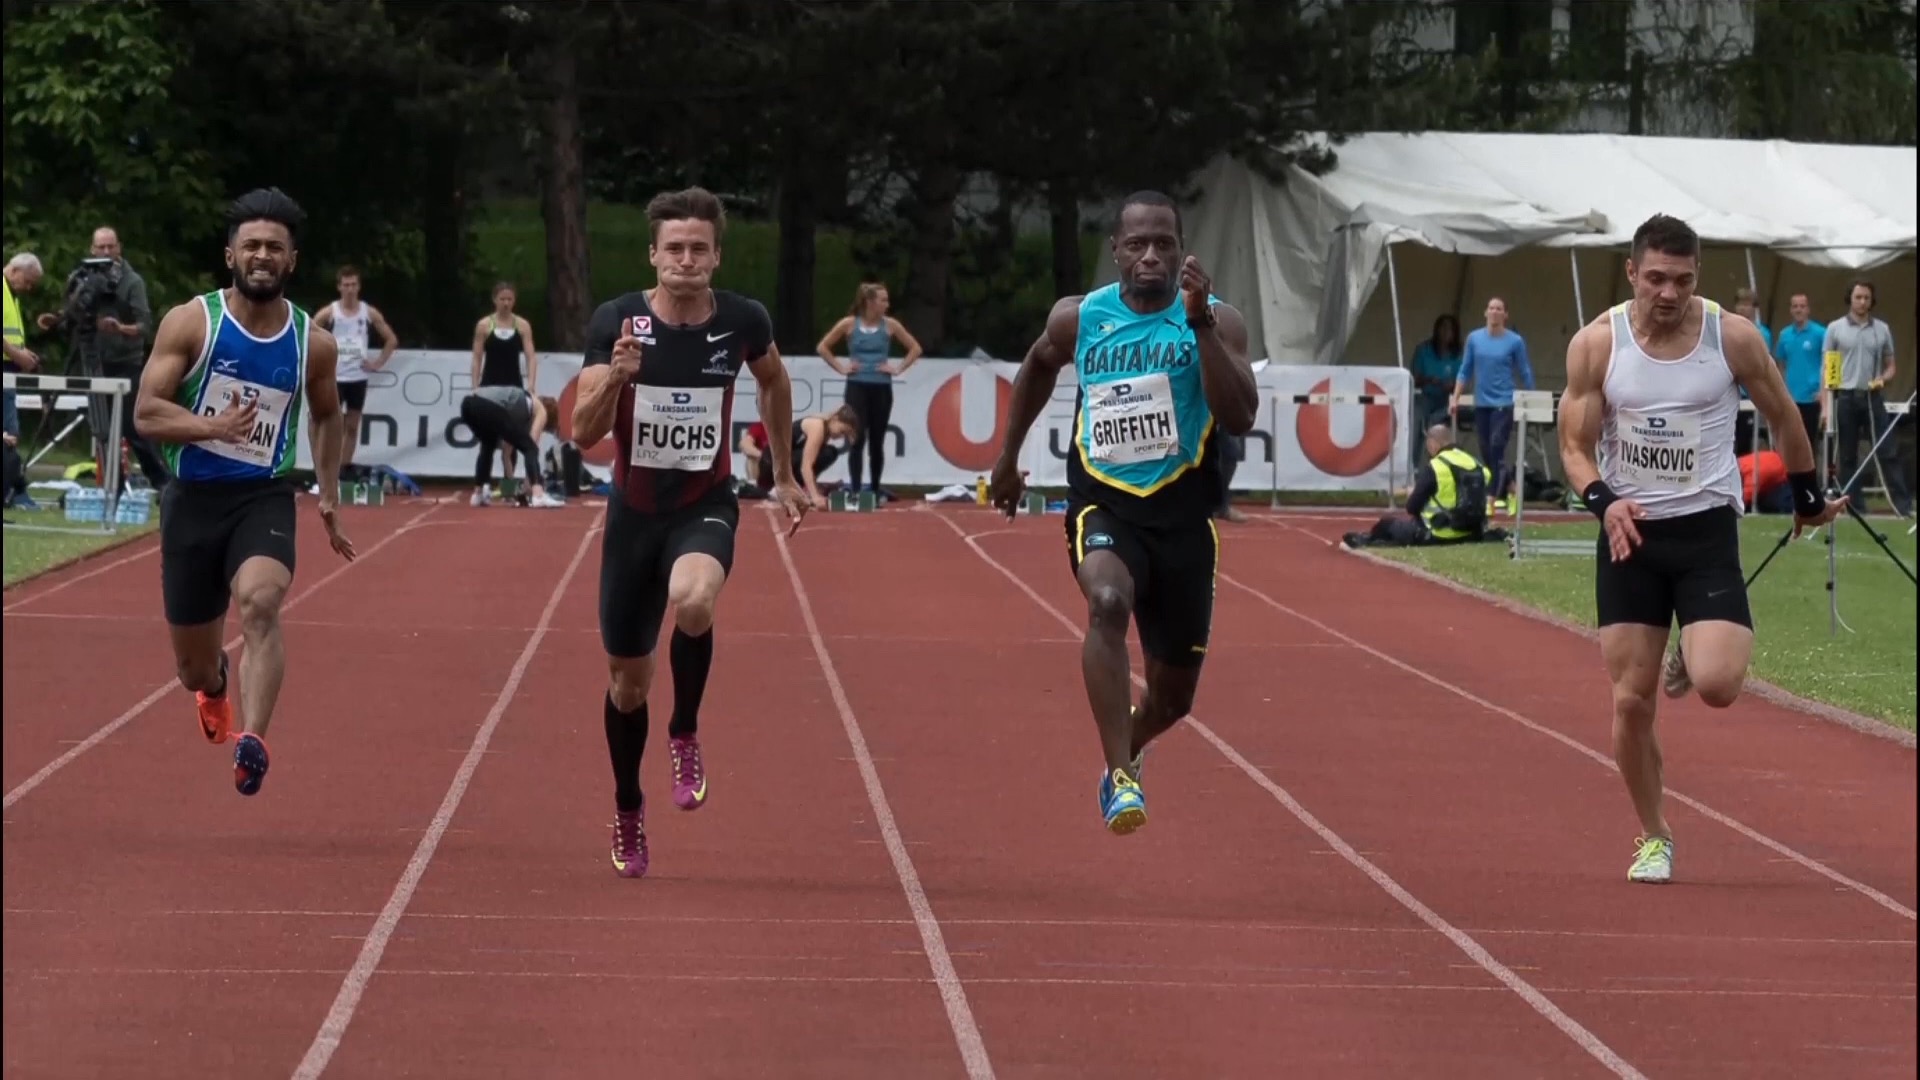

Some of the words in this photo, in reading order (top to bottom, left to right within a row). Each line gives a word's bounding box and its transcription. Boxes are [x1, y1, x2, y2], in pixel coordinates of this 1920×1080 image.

[1083, 341, 1193, 376] BAHAMAS
[653, 404, 707, 413] TRANSDANUBIA
[638, 422, 716, 450] FUCHS
[1093, 411, 1171, 447] GRIFFITH
[1631, 425, 1684, 438] TRANSDANUBIA
[1134, 443, 1157, 453] SPORT
[1621, 440, 1694, 472] IVASKOVIC
